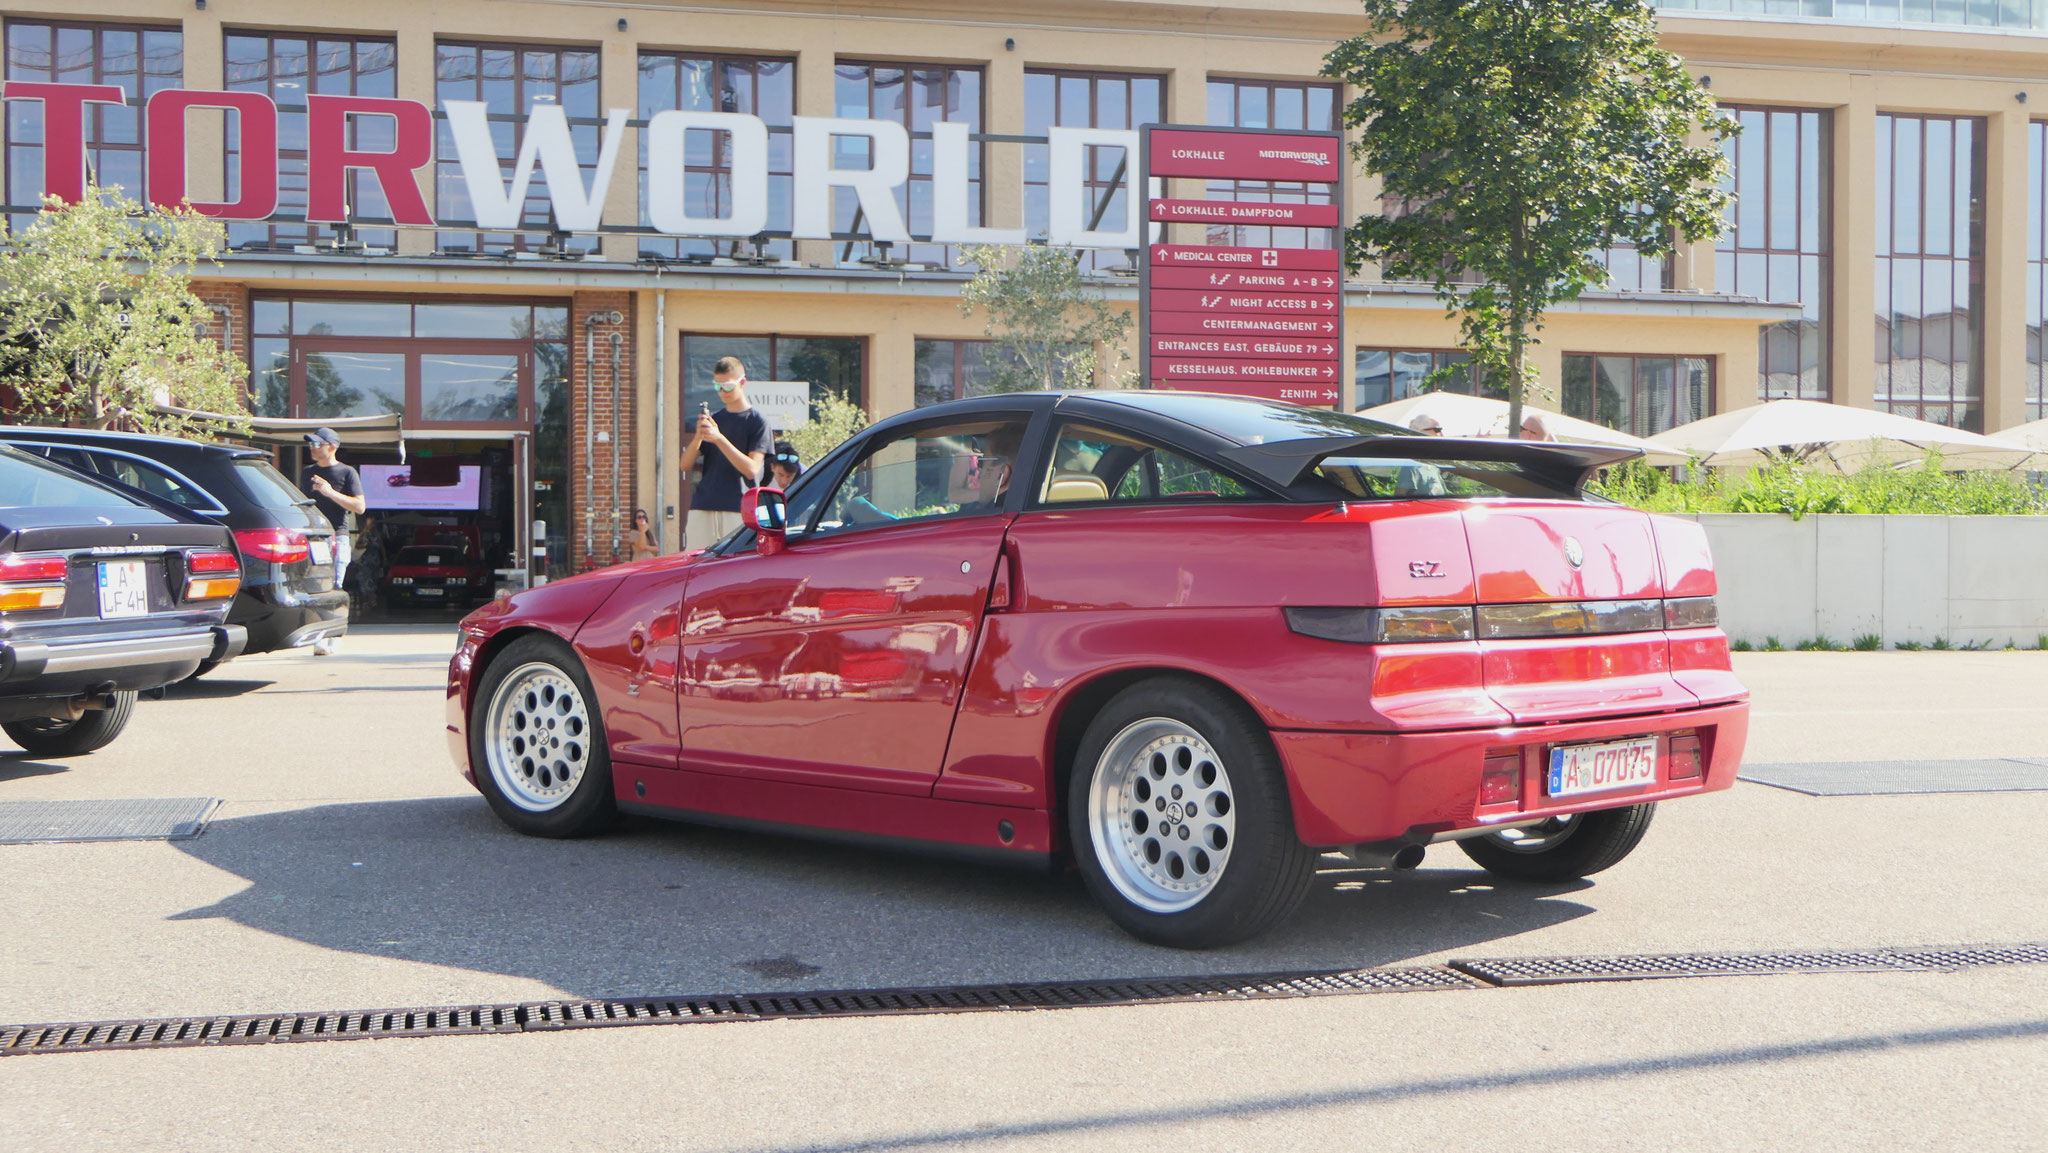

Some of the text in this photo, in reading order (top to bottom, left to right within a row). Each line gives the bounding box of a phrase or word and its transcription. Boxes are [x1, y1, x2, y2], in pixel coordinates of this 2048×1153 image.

[1172, 149, 1225, 160] LOKHALLE
[1259, 150, 1328, 161] MOTORWORLD
[1231, 207, 1293, 218] DAMPFDOM
[1174, 251, 1253, 263] MEDICAL CENTER
[1239, 275, 1285, 286] PARKING
[1311, 278, 1318, 286] B
[1230, 298, 1318, 309] NIGHT ACCESS B
[1203, 319, 1318, 331] CENTERMANAGEMENT
[1158, 341, 1219, 351] ENTRANCES
[1254, 342, 1303, 353] GEBÄUDE
[1306, 345, 1318, 353] 79
[1241, 366, 1318, 377] KOHLEBUNKER
[1280, 389, 1317, 399] ZENITH
[1409, 560, 1446, 578] SZ
[119, 566, 128, 588] A
[1553, 745, 1653, 789] D A 07075
